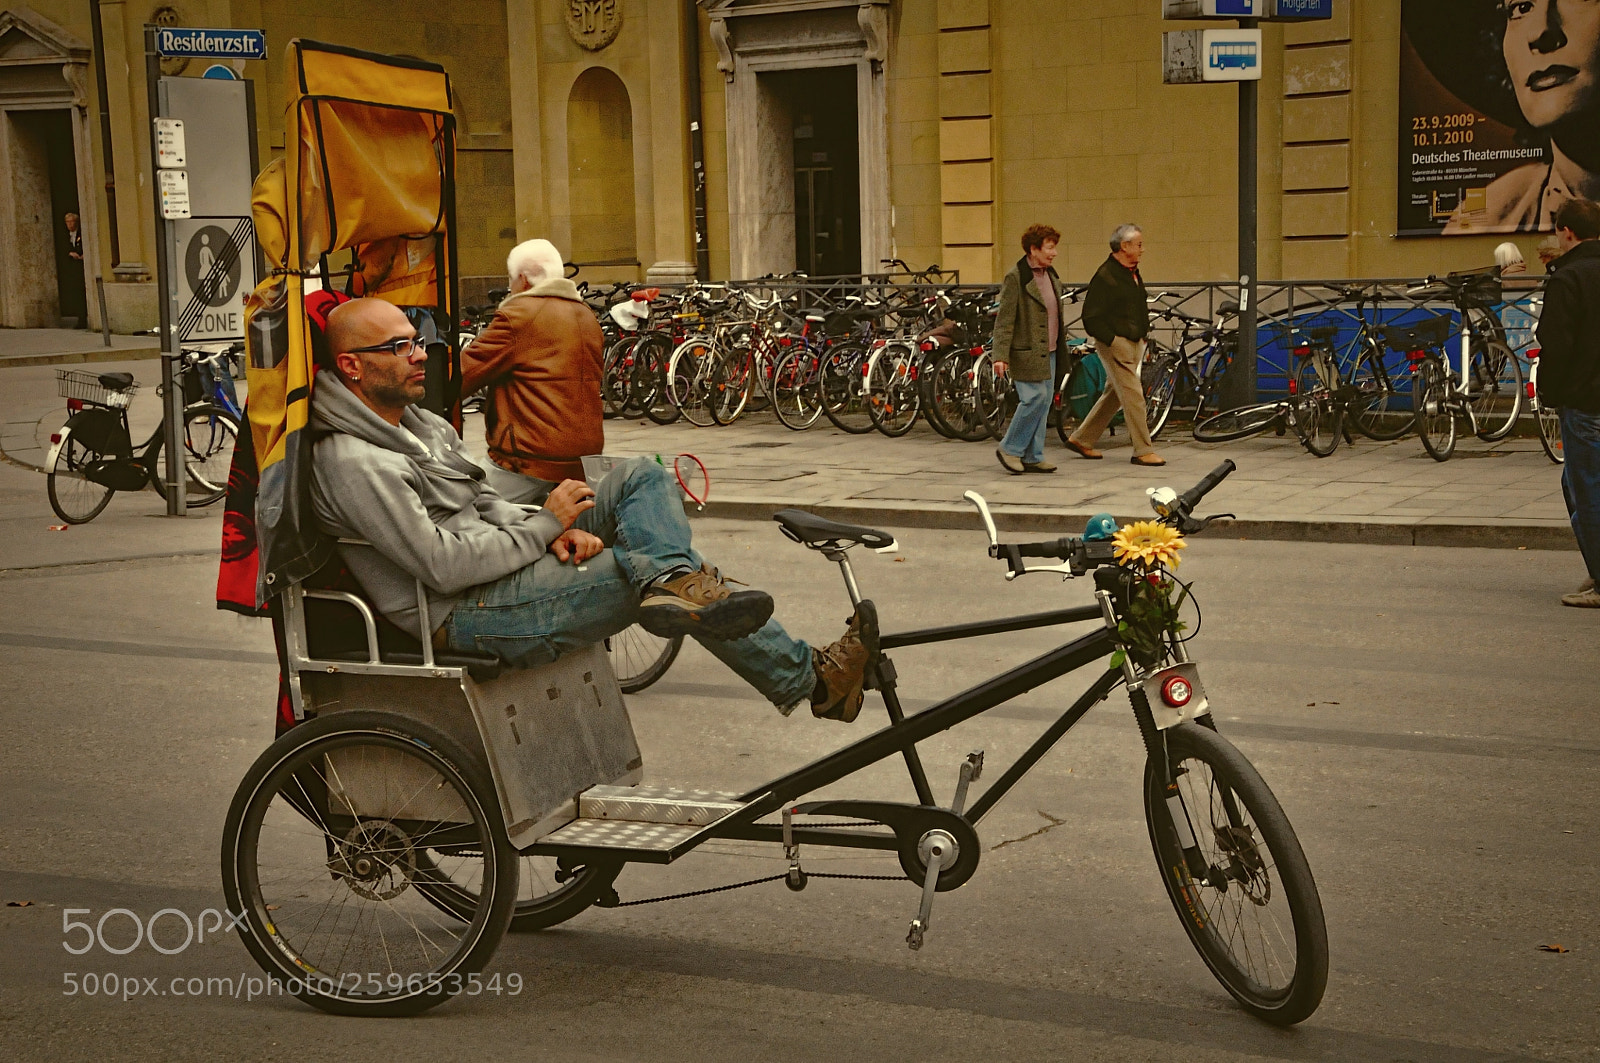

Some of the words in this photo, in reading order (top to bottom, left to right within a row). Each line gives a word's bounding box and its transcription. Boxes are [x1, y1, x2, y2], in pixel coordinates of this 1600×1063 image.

[162, 31, 259, 53] Residenzstr.
[1412, 151, 1460, 165] Deutsches
[1462, 147, 1543, 161] Theatermuseum
[195, 313, 238, 333] ZONE
